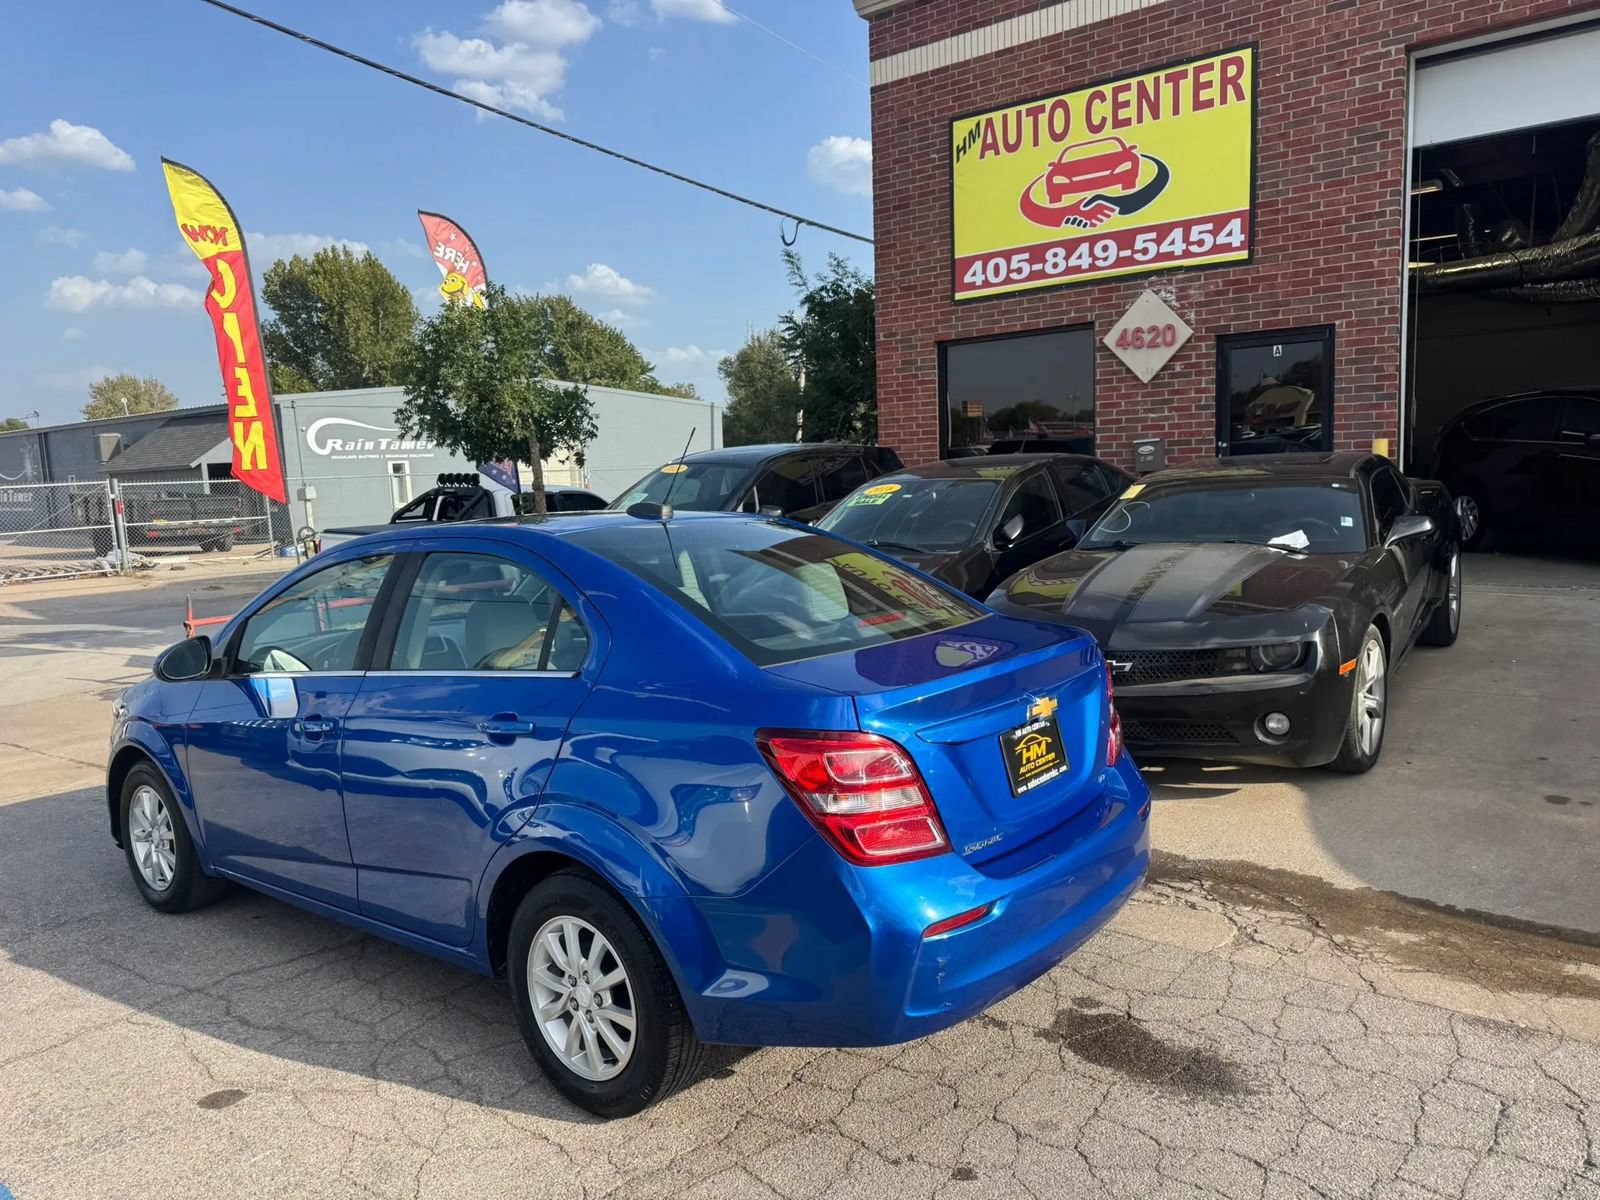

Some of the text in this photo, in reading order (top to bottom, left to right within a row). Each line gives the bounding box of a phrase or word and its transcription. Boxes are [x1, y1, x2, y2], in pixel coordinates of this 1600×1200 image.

[956, 55, 1246, 163] HM AUTO CENTER
[963, 218, 1246, 286] 405-849-5454
[1115, 323, 1177, 350] 4620
[328, 438, 375, 451] Rain
[1019, 762, 1036, 775] AUTO
[1035, 752, 1056, 766] CENTER
[1022, 739, 1047, 765] HM
